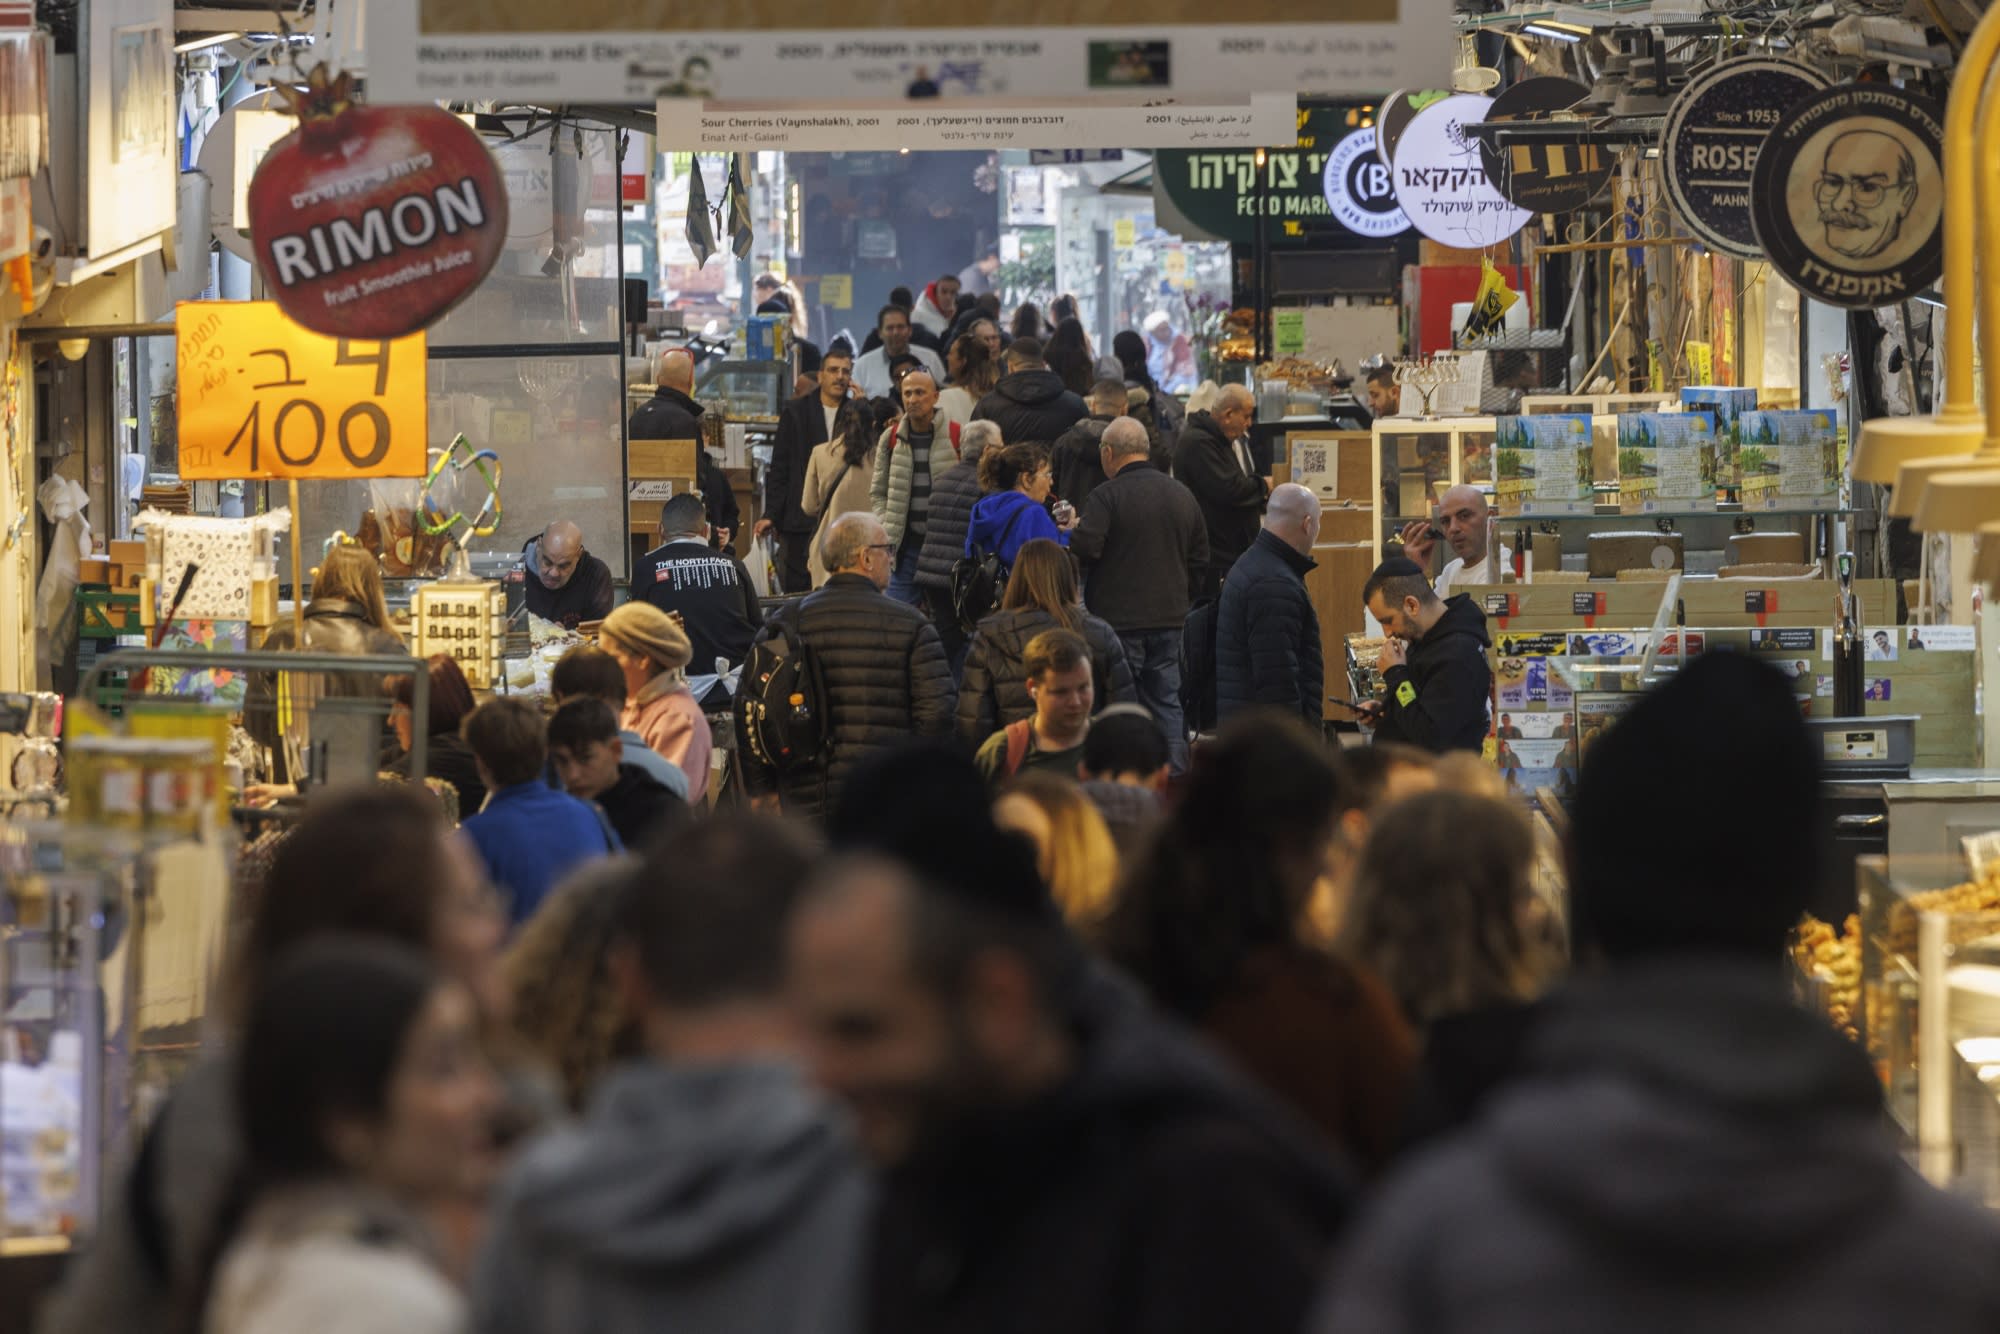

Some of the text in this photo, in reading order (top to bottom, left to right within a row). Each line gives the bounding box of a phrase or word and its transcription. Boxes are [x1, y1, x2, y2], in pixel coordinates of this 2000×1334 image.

[701, 118, 725, 127] Sour
[729, 117, 773, 127] Cherries
[856, 118, 880, 126] 2001
[897, 117, 920, 126] 2001
[985, 116, 1019, 125] חמוצים
[1145, 115, 1171, 124] 2001
[1747, 109, 1780, 123] 1953
[701, 133, 726, 142] Einat
[1402, 166, 1486, 193] הקקאו
[1422, 198, 1473, 216] שוקולד
[1712, 194, 1749, 207] MAHN
[271, 178, 484, 286] RIMON
[359, 262, 432, 296] Smoothie
[434, 250, 473, 273] Juice
[223, 398, 391, 472] 100
[656, 556, 733, 569] THE NORTH FACE
